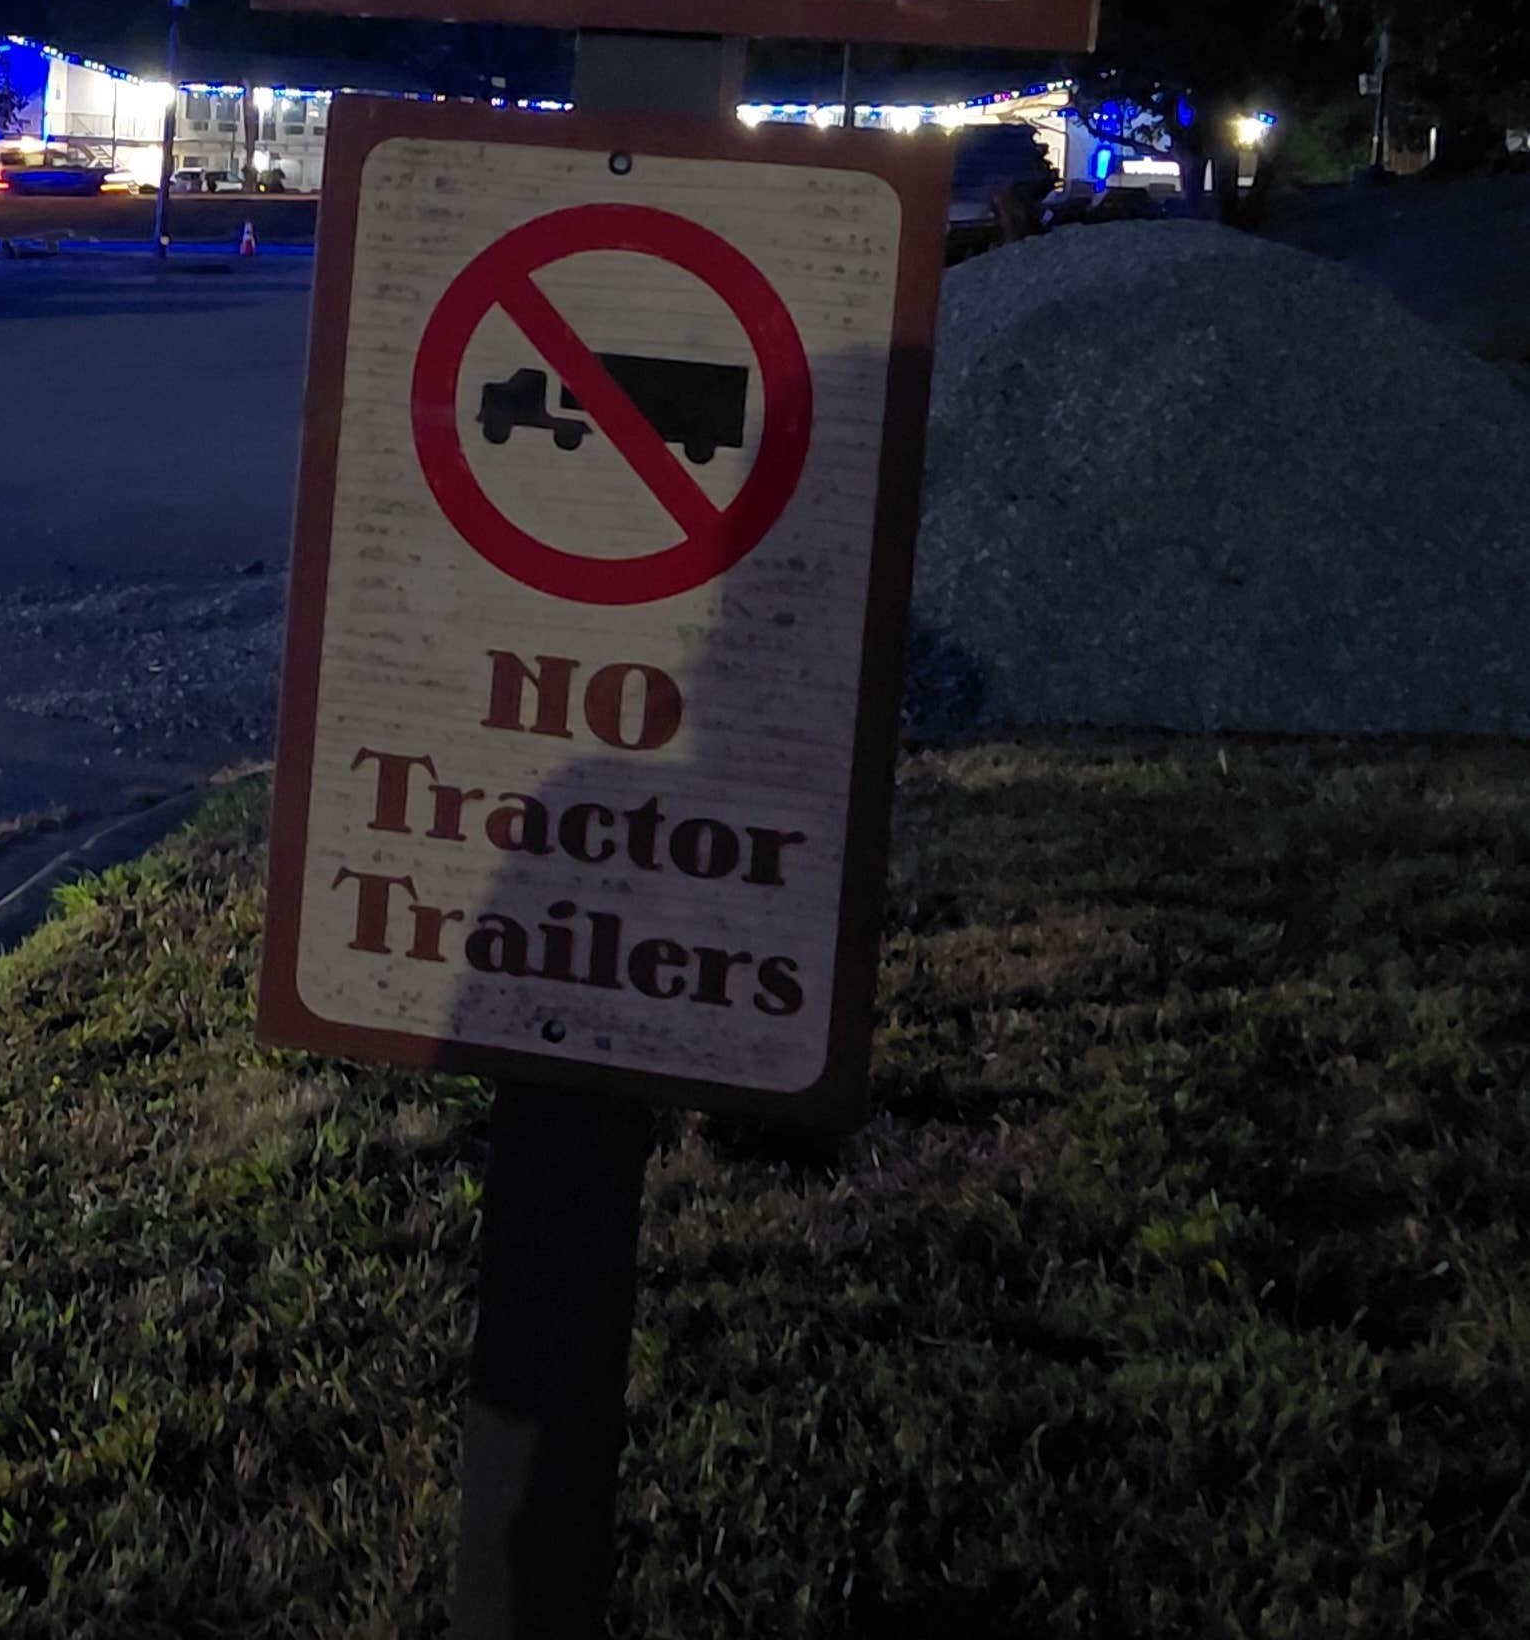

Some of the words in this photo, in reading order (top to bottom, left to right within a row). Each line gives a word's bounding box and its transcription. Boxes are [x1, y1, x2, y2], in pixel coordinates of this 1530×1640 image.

[480, 649, 683, 751] NO
[350, 746, 807, 887] Tractor
[331, 866, 805, 1017] Trailers
